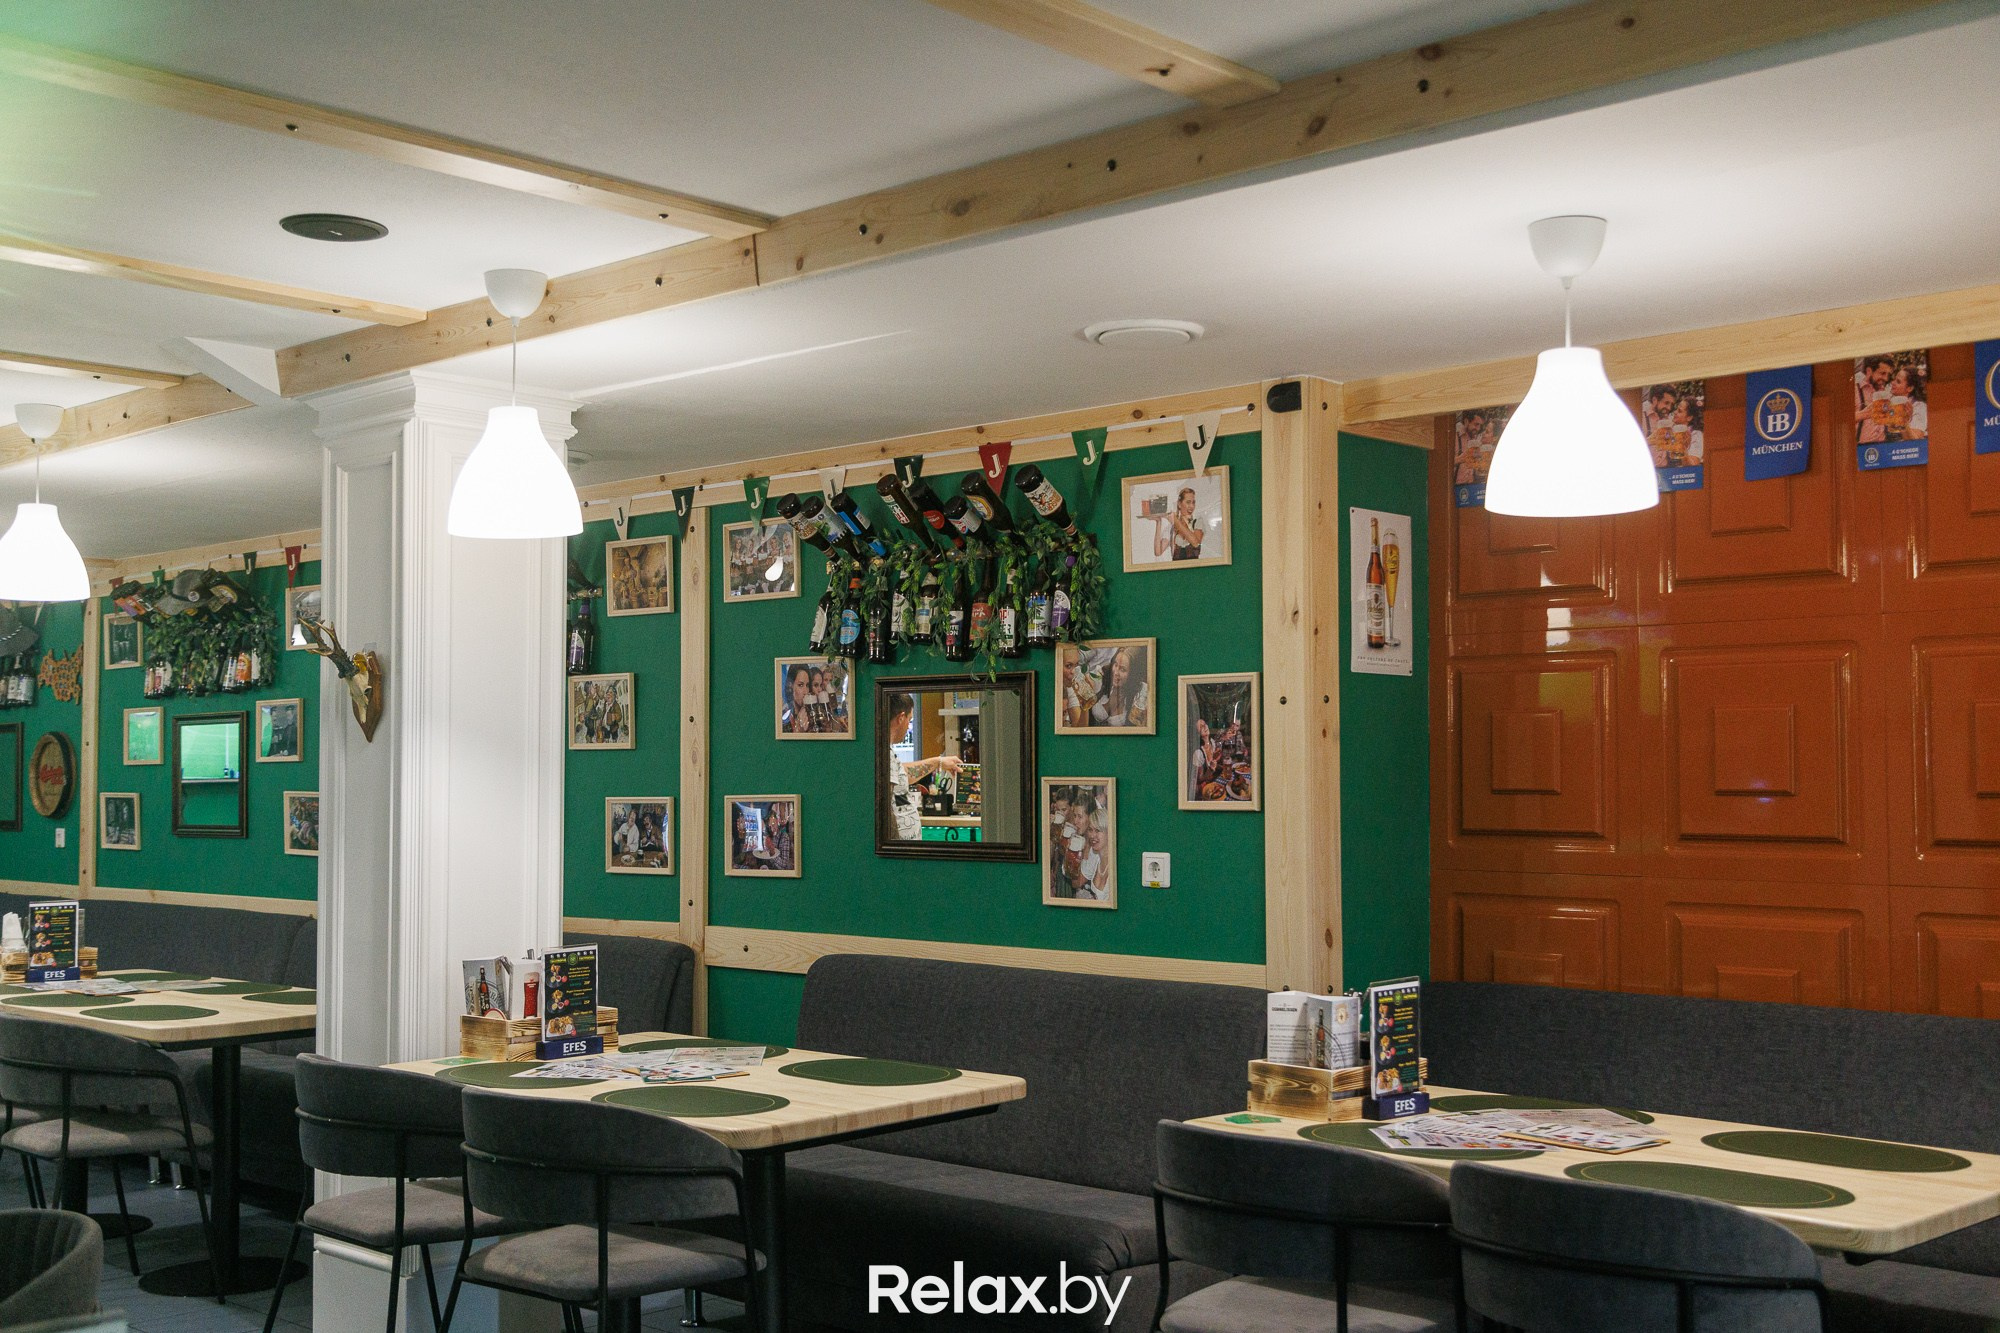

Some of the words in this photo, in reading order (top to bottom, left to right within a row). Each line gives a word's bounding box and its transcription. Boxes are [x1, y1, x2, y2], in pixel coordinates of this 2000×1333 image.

[1767, 413, 1790, 432] HB
[1752, 441, 1803, 455] MÜNCHEN
[43, 970, 67, 979] EFES
[563, 1040, 587, 1053] EFES
[1394, 1098, 1416, 1112] EFES
